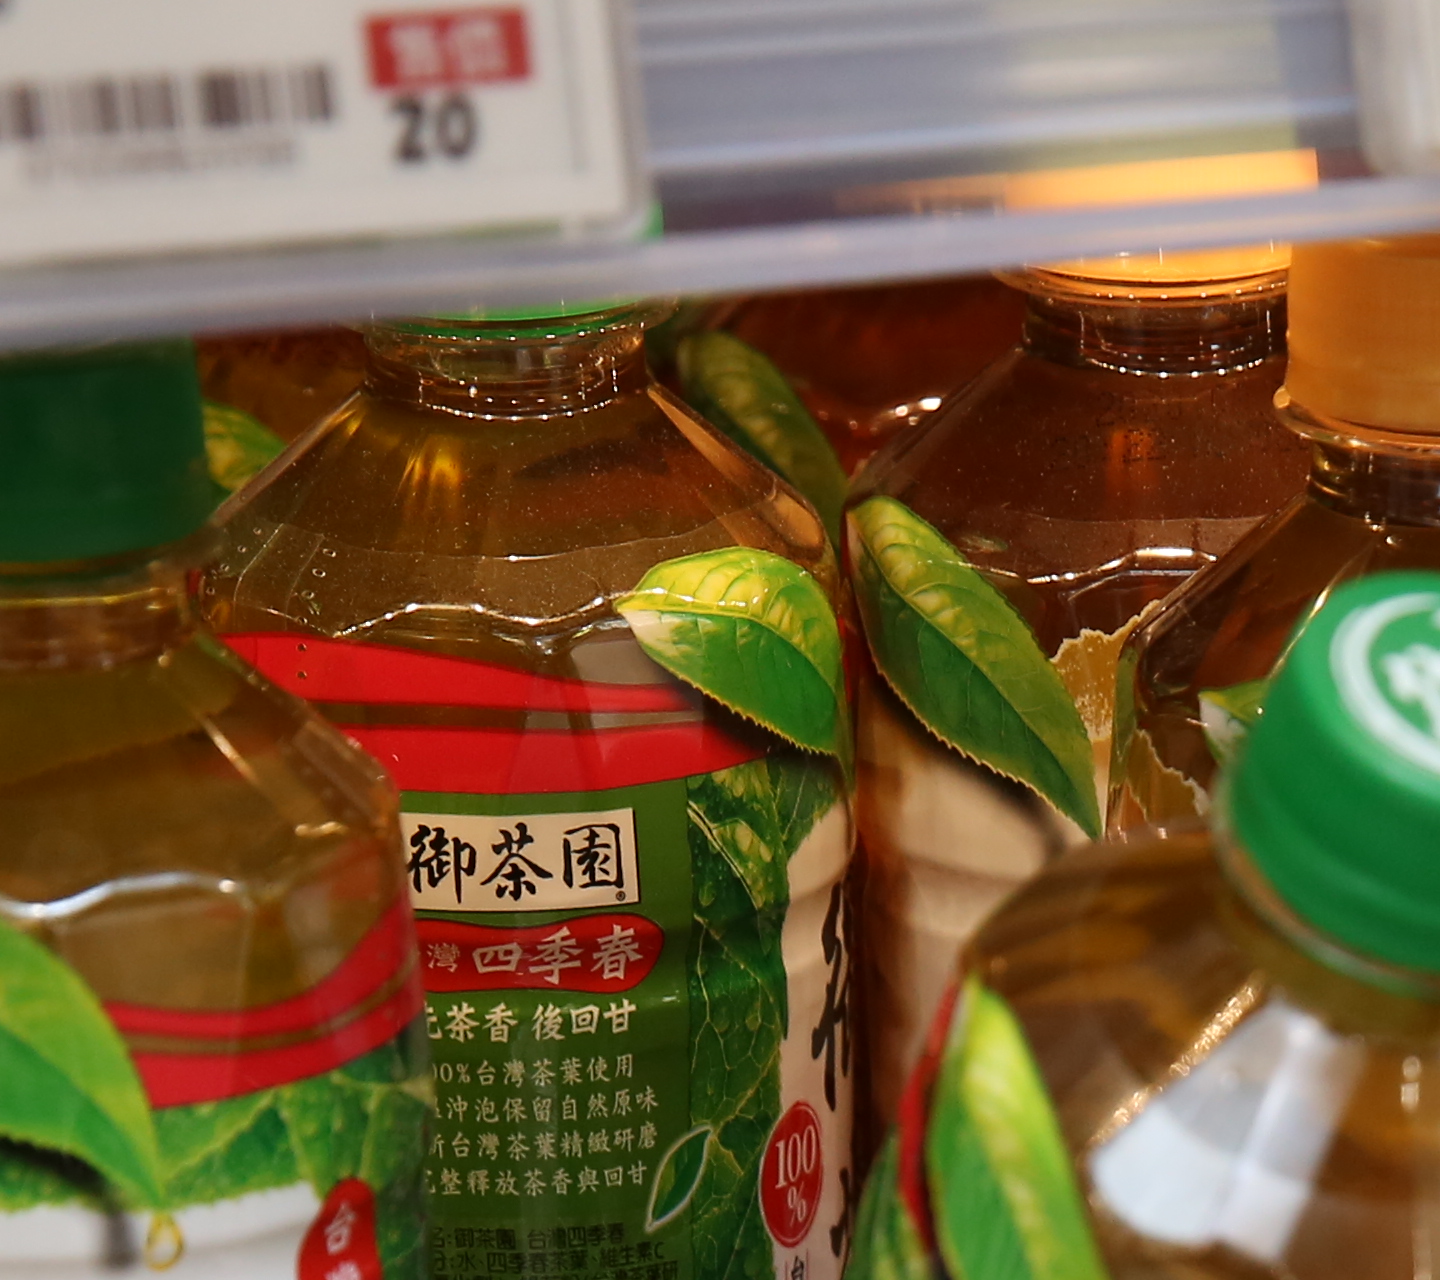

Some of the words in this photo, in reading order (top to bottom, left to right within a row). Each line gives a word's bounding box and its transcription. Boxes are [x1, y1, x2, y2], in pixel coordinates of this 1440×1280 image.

[388, 94, 478, 164] 20
[407, 822, 626, 903] 御茶園
[531, 997, 639, 1042] 後回甘
[431, 1052, 636, 1088] 0%台灣茶葉使用
[432, 1084, 661, 1124] 沖泡保留自然原味
